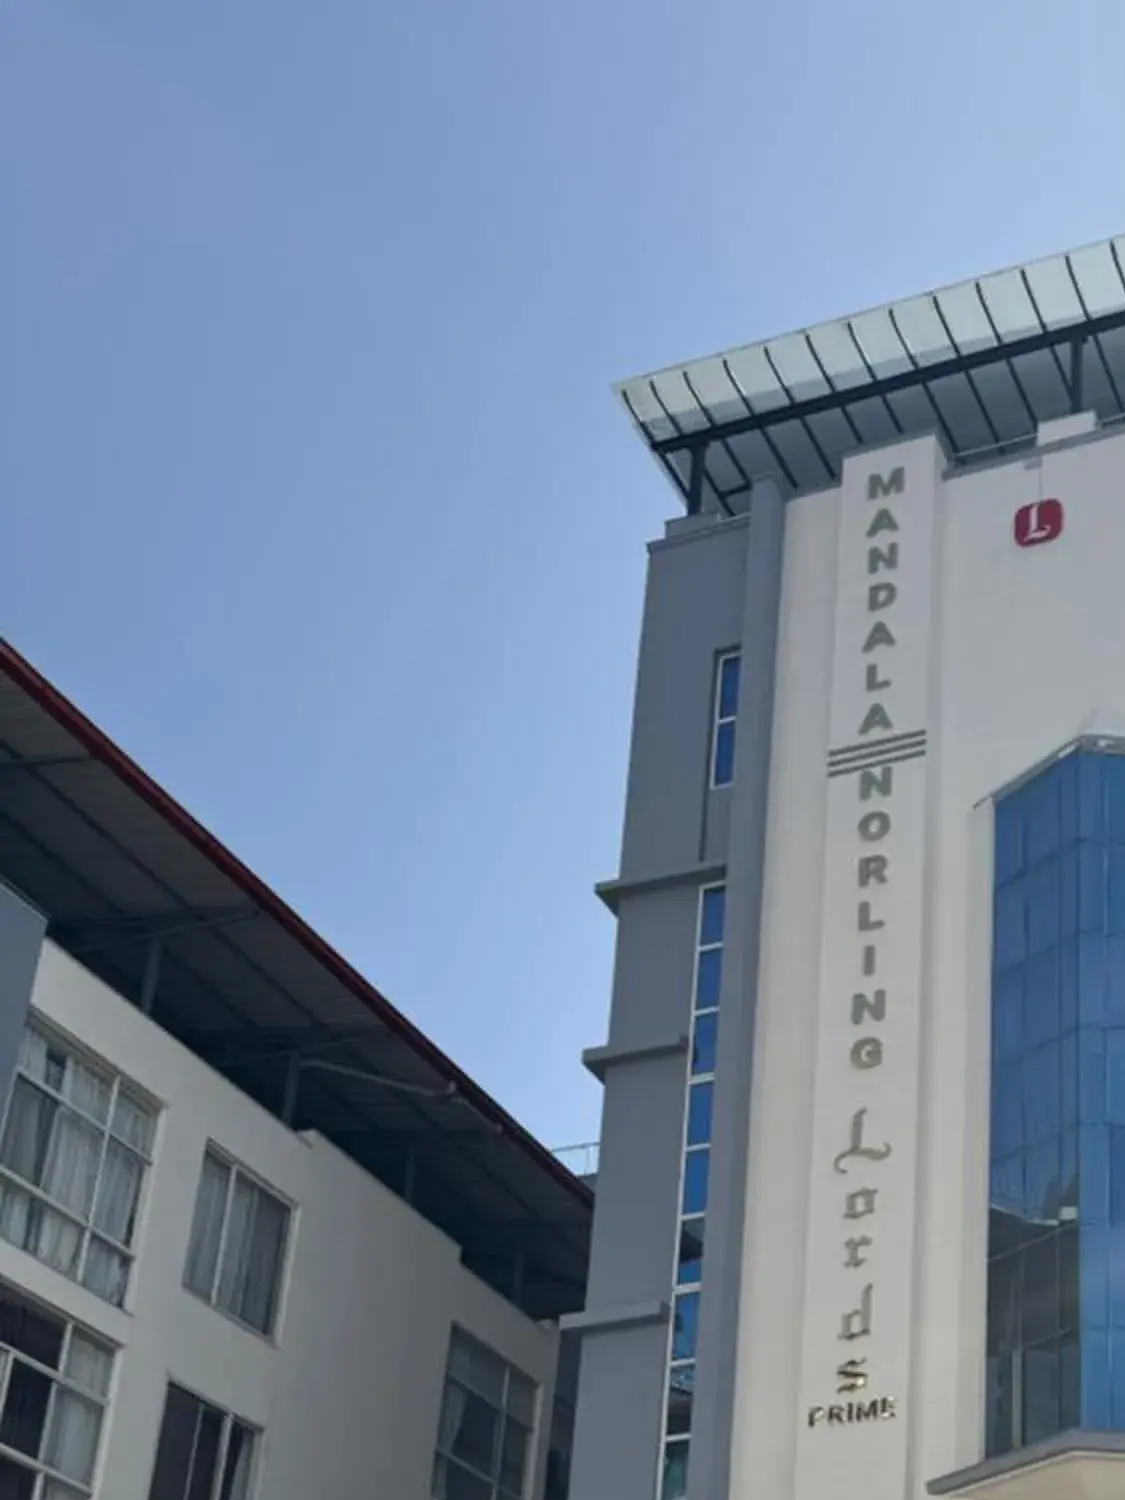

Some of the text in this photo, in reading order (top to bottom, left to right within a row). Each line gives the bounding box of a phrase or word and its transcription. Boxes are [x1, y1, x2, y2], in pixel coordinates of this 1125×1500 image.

[832, 467, 904, 1394] MANDALA NORLING Lords
